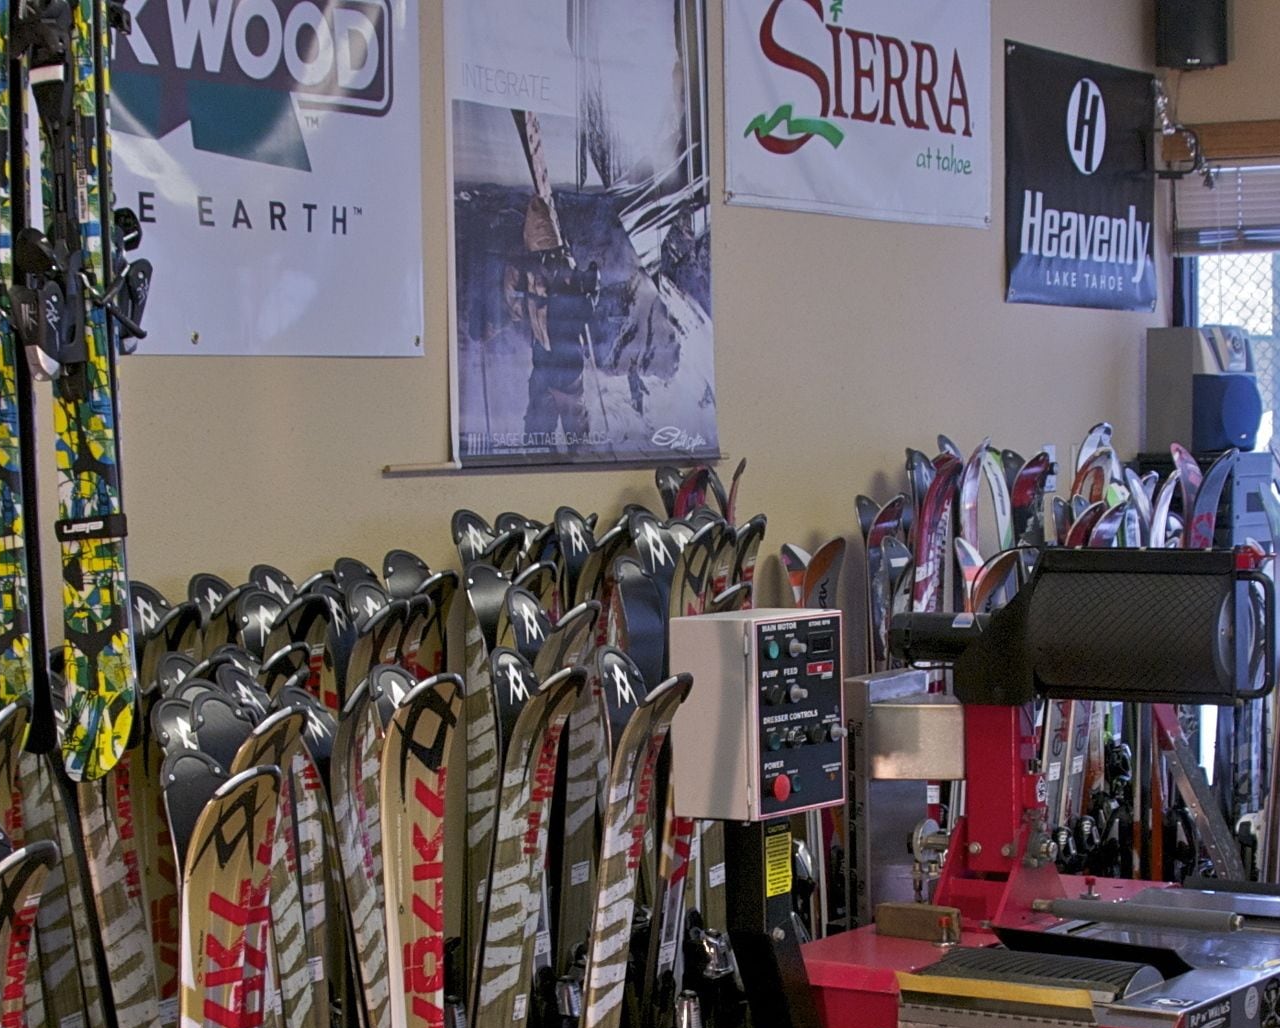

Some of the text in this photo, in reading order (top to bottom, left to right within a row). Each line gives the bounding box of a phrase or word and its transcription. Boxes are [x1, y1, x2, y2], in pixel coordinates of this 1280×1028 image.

[461, 62, 551, 100] INTEGRATE
[759, 0, 972, 154] SIERRA
[916, 144, 972, 175] at tahoe
[198, 196, 348, 236] EARTH
[1021, 190, 1151, 284] Heavenly
[1046, 270, 1123, 291] LAKE TAHOE
[492, 432, 520, 447] SAGE
[777, 622, 797, 630] MOTOR
[784, 667, 798, 676] FEED
[763, 714, 788, 725] DRESSER
[789, 709, 818, 720] CONTROLS
[764, 760, 784, 770] POWER
